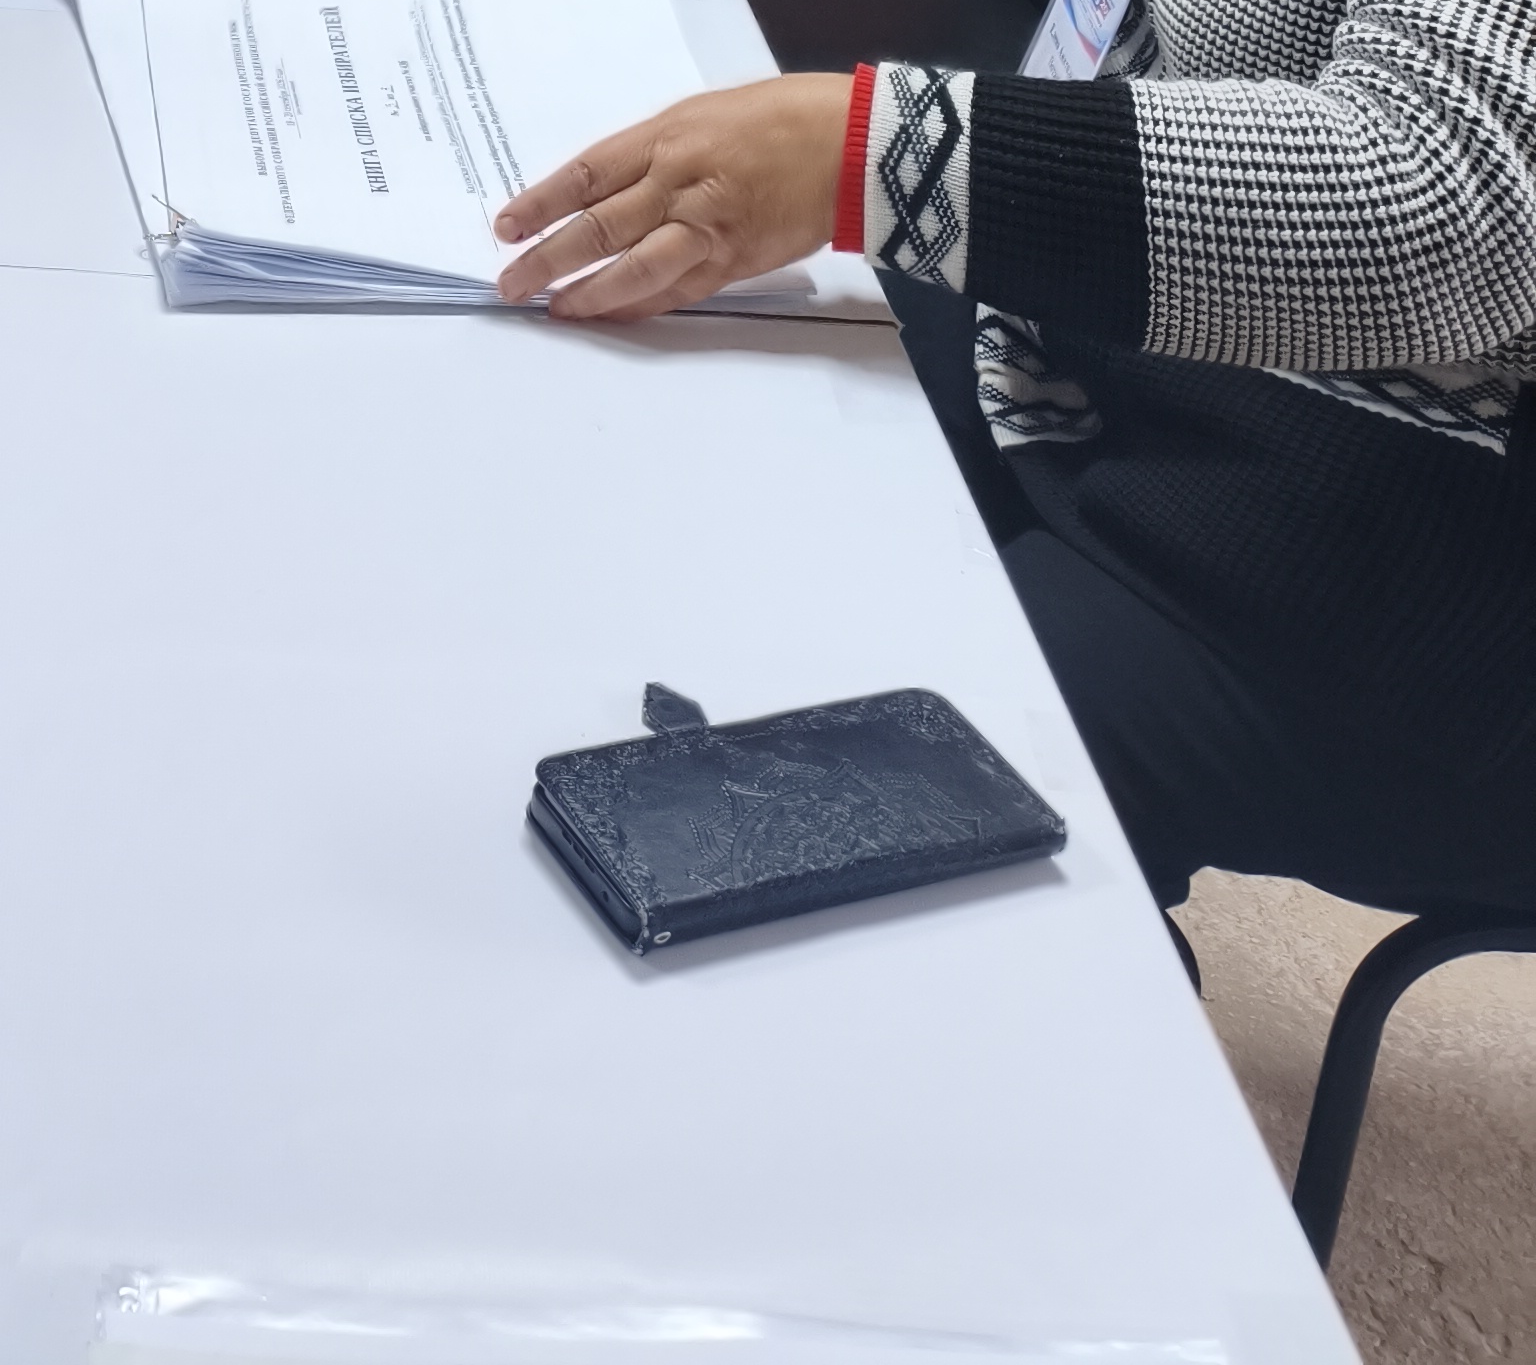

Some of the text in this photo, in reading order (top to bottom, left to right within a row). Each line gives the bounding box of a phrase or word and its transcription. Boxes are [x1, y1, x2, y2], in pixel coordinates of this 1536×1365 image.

[254, 83, 274, 126] РОССИЙСКОЙ
[320, 6, 389, 193] КНИГА СПИСКА ИЗБИРАТЕЛЕЙ
[244, 107, 263, 145] ДЕПУТАТОВ
[253, 146, 268, 176] ВЫБОРЫ
